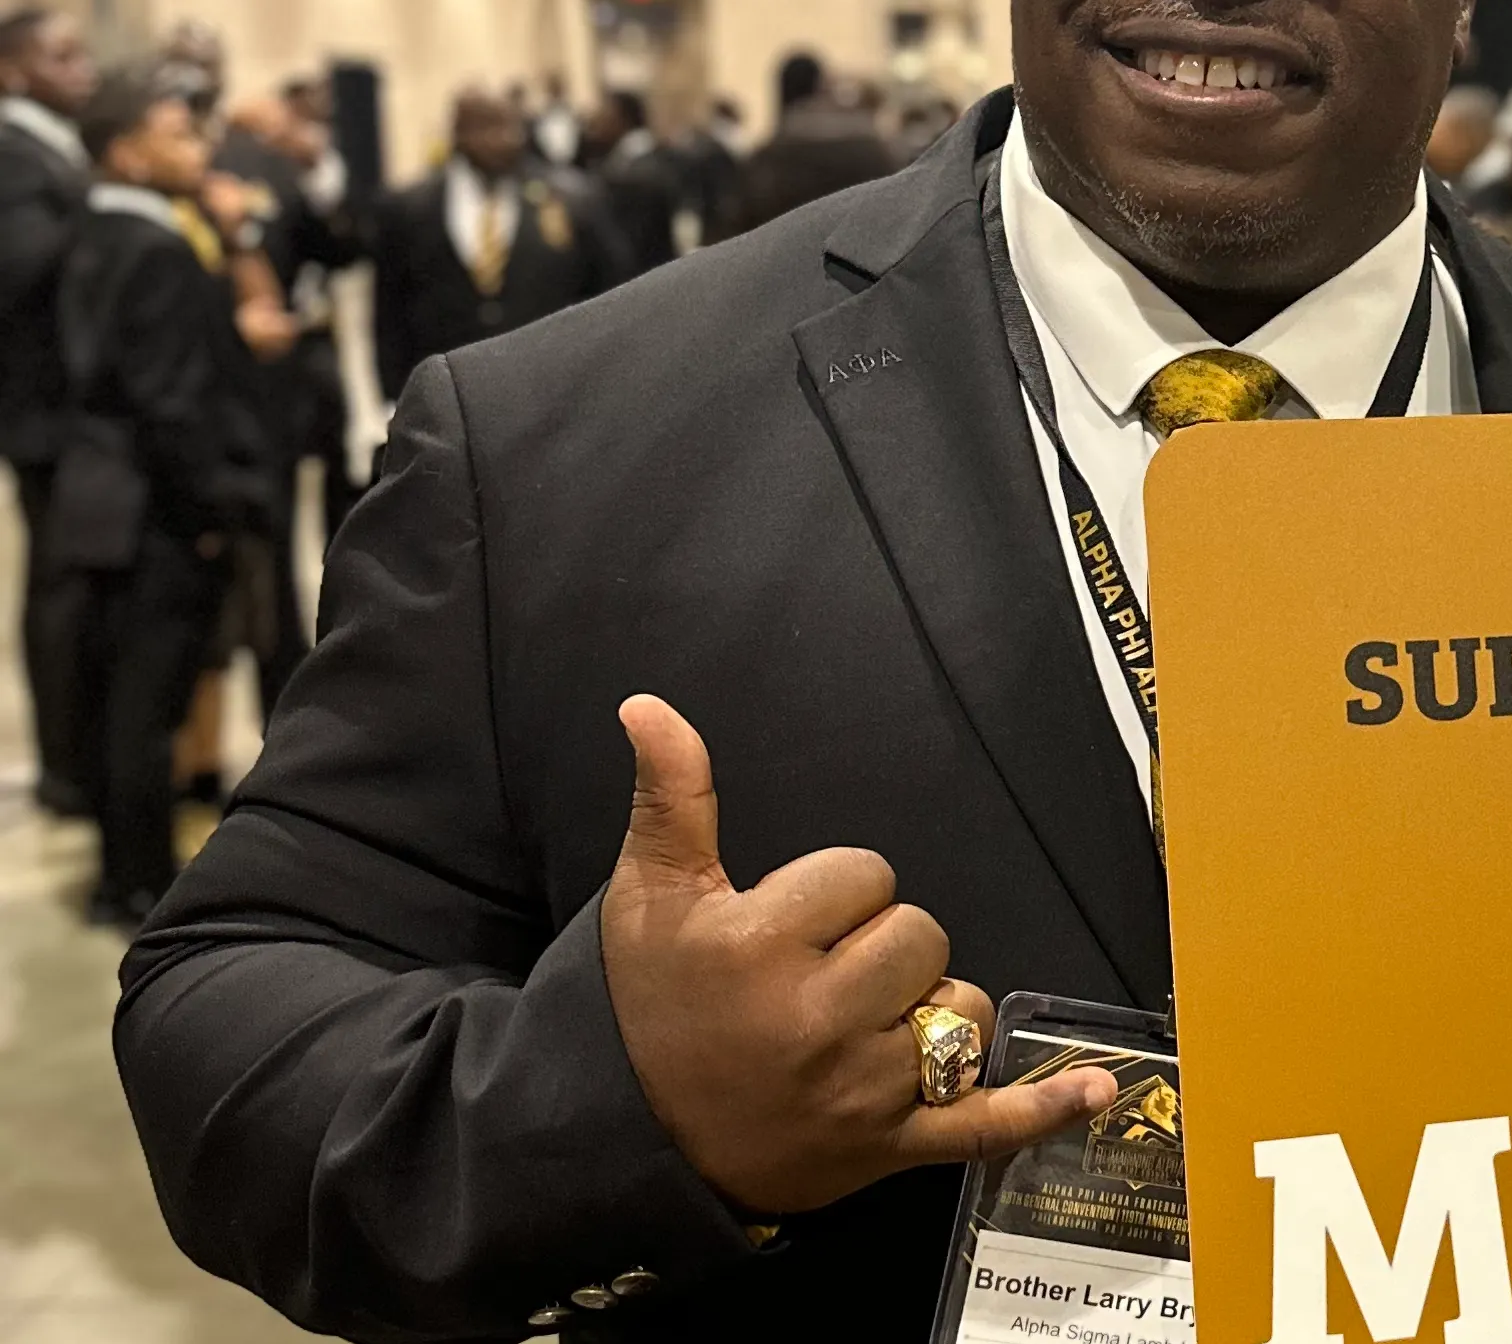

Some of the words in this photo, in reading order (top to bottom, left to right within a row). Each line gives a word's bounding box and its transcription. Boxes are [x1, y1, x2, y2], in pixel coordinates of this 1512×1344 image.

[1072, 510, 1124, 609] ALPHA
[1109, 606, 1150, 661] PHI
[1128, 666, 1157, 713] AL
[1023, 1193, 1060, 1213] GENERAL
[1061, 1199, 1115, 1222] CONVENTION
[1145, 1213, 1189, 1233] ANNIVERS
[1041, 1182, 1073, 1198] ALPHA
[1077, 1187, 1095, 1201] PHI
[1099, 1190, 1130, 1206] ALPHA
[975, 1267, 1077, 1303] Brother
[1083, 1284, 1152, 1320] Larry
[1010, 1316, 1061, 1338] Alpha
